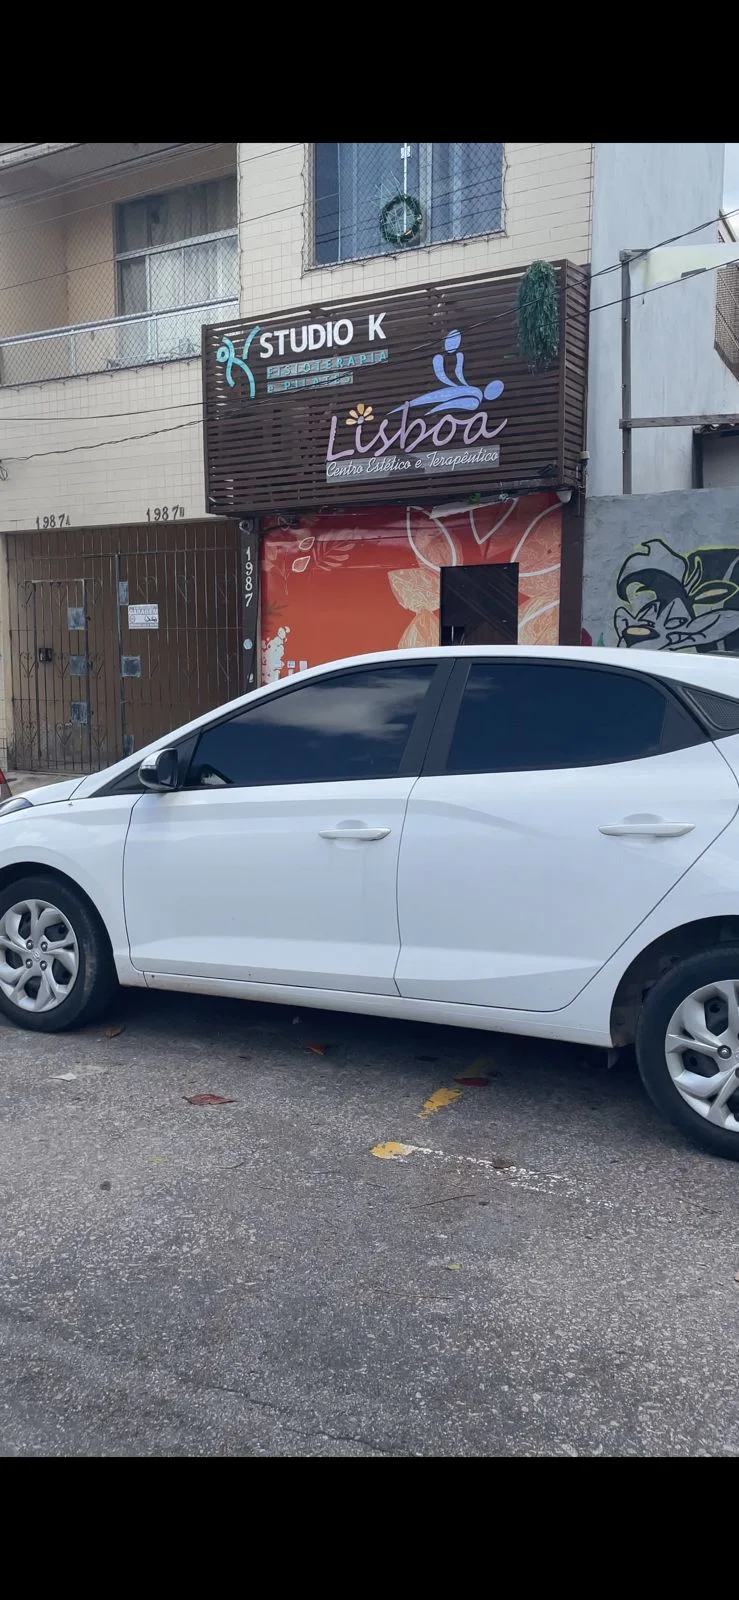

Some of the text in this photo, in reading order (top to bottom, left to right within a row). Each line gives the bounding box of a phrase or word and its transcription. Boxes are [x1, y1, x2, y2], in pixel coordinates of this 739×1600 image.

[260, 312, 387, 359] STUDIO K
[267, 351, 388, 378] FISIOTERAPIA
[326, 400, 508, 462] Lisboa
[326, 448, 499, 477] Centro Estético e Terapêutico
[244, 546, 253, 607] 1987
